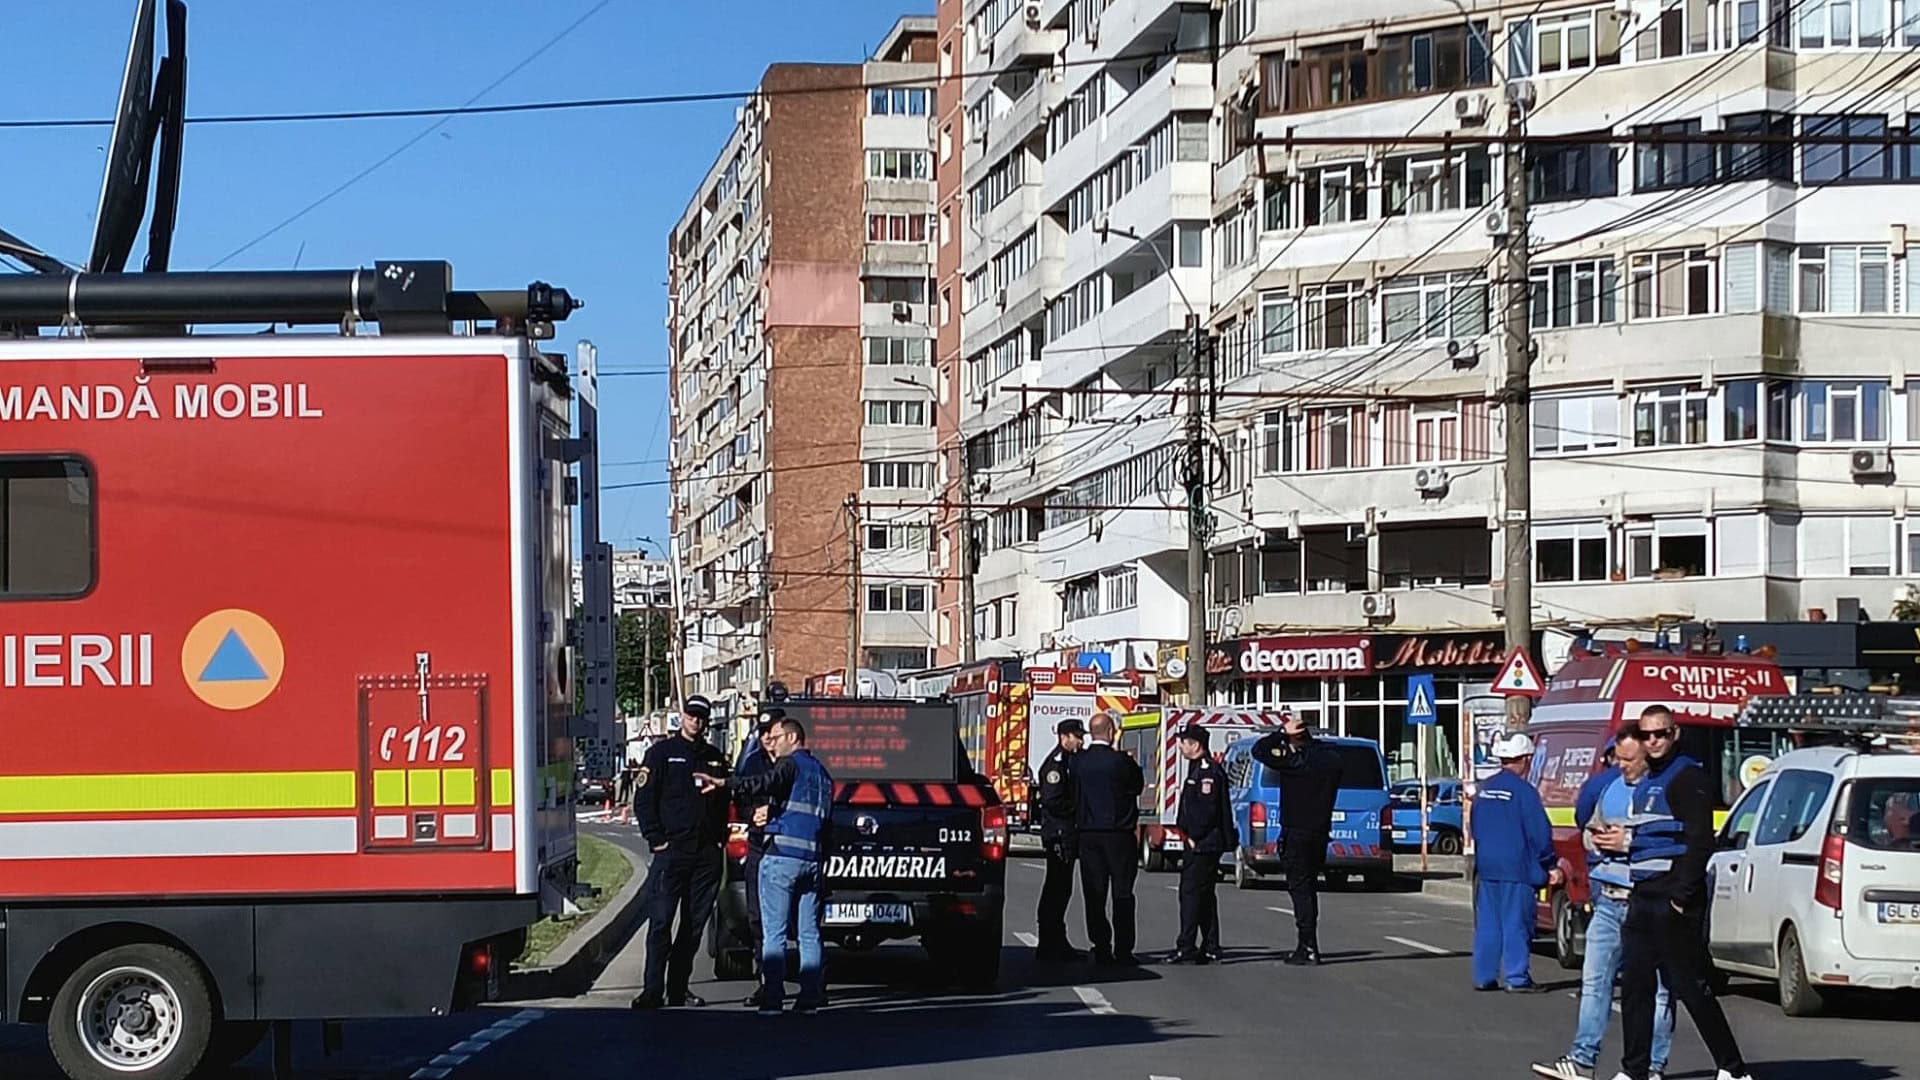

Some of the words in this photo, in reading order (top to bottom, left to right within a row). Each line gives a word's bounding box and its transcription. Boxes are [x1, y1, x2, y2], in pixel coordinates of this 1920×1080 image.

[174, 383, 323, 418] MOBIL
[4, 633, 152, 687] IERII
[1240, 642, 1366, 672] decorama
[402, 726, 467, 761] 112
[950, 830, 972, 842] 112
[823, 855, 947, 878] DARMERIA
[839, 904, 859, 918] MAI
